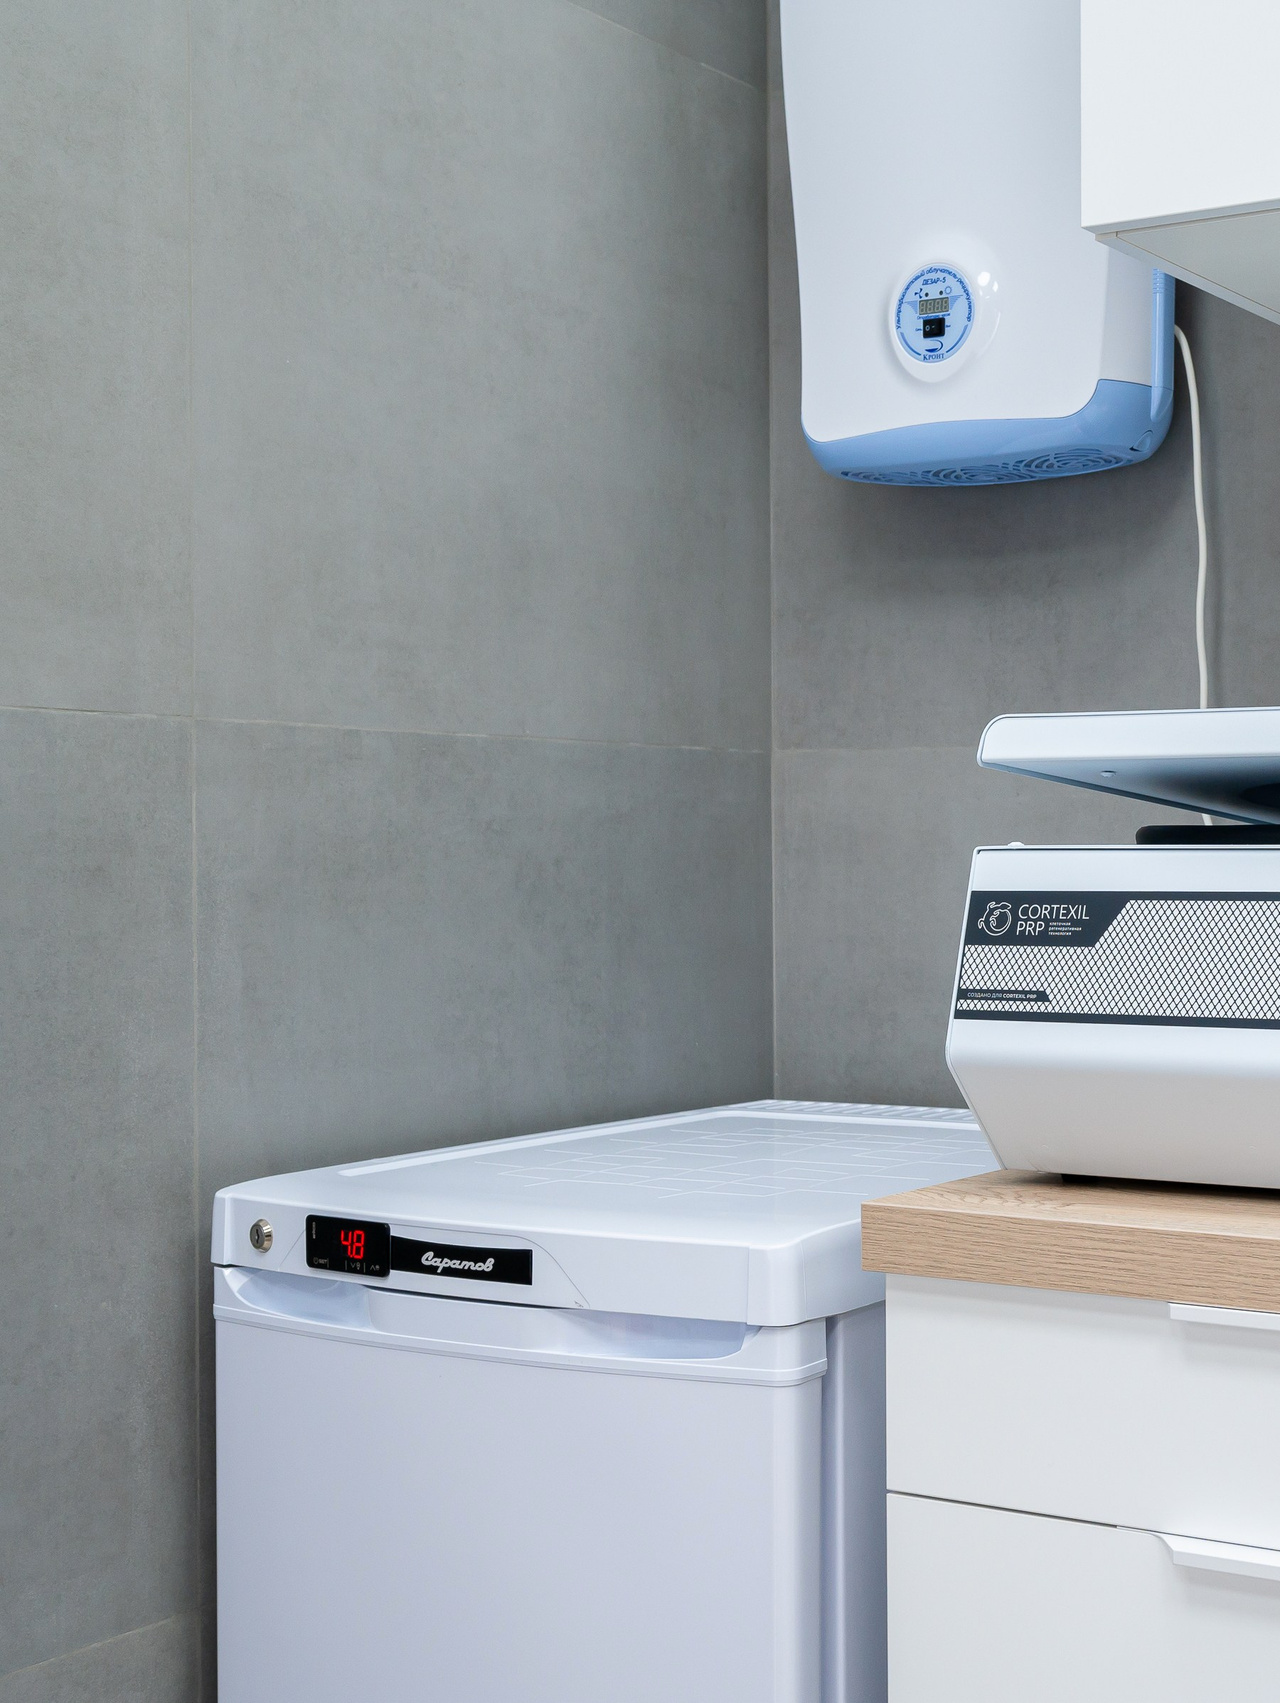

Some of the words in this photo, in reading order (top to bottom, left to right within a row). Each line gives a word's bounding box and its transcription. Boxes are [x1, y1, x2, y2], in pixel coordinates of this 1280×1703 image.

[923, 353, 945, 361] КРОНТ
[1018, 904, 1090, 920] CORTEXIL
[1016, 921, 1045, 936] PRP
[421, 1251, 495, 1273] Саратов
